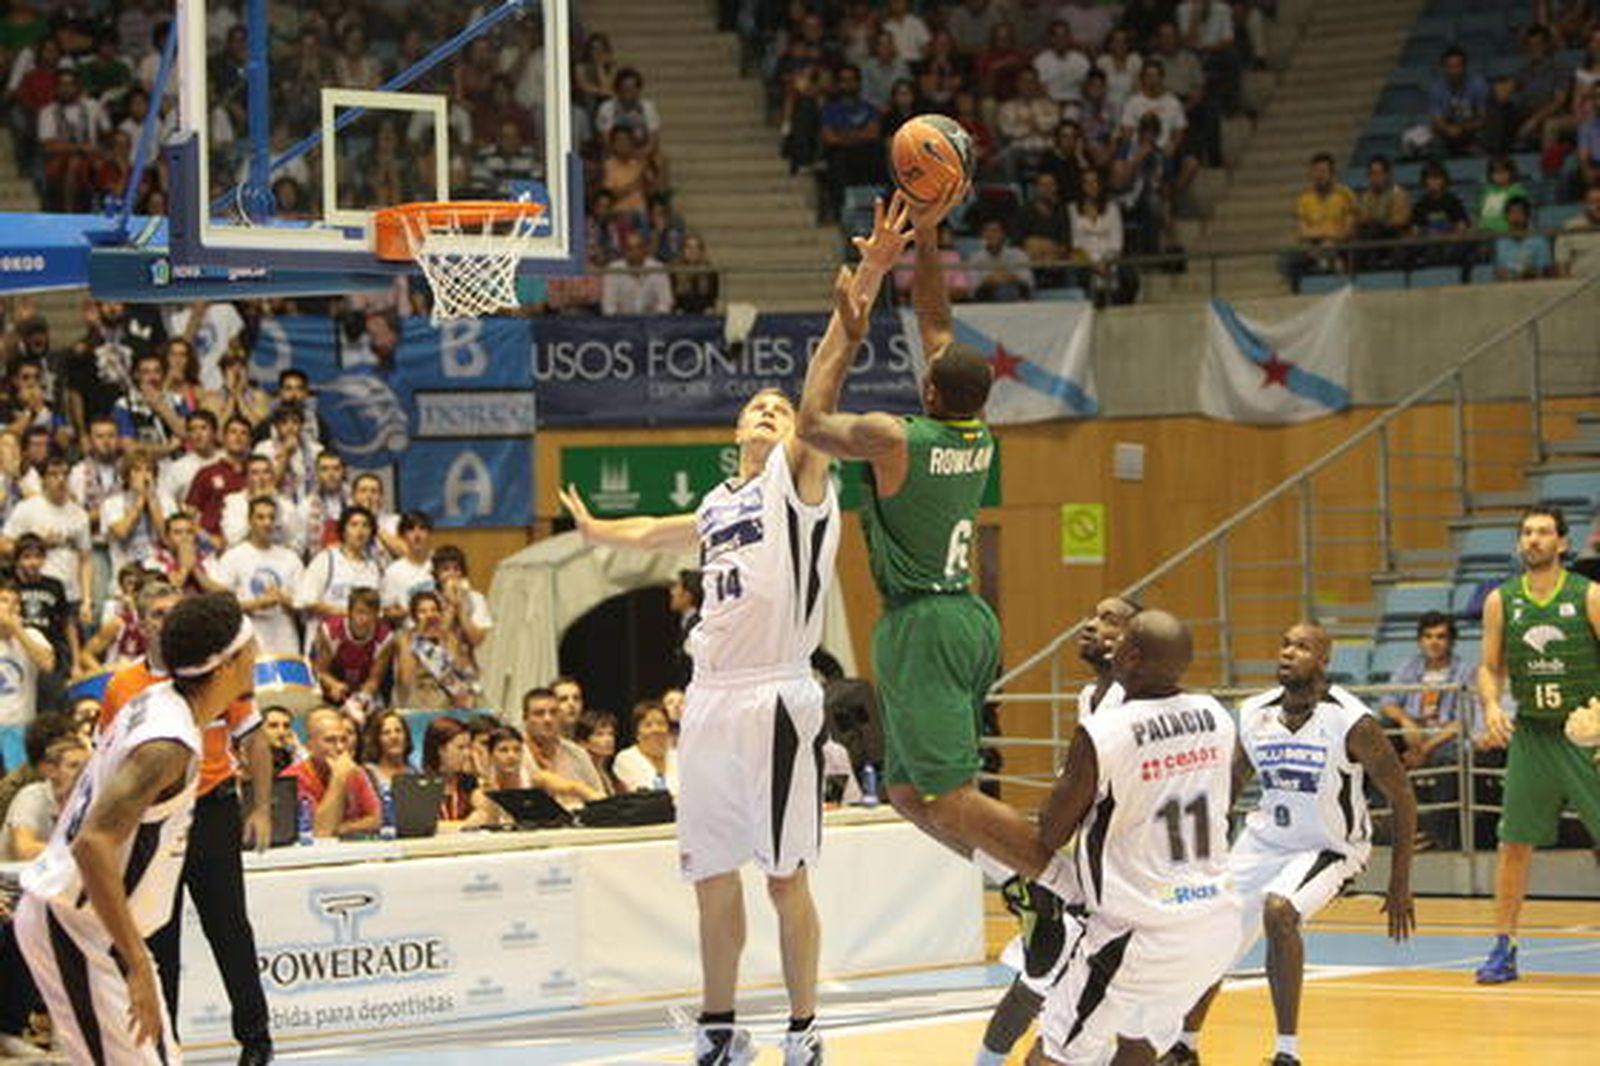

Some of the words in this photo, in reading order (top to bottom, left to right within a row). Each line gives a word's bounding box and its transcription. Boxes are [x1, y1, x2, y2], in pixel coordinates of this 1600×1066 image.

[441, 319, 489, 377] B
[531, 340, 635, 381] USOS
[445, 450, 493, 515] A
[716, 567, 742, 601] 14
[1535, 683, 1563, 709] 15
[1131, 708, 1217, 747] PALACIO
[1155, 793, 1210, 862] 11
[270, 1005, 312, 1029] bida
[315, 1003, 354, 1028] para
[358, 996, 455, 1024] deportistas
